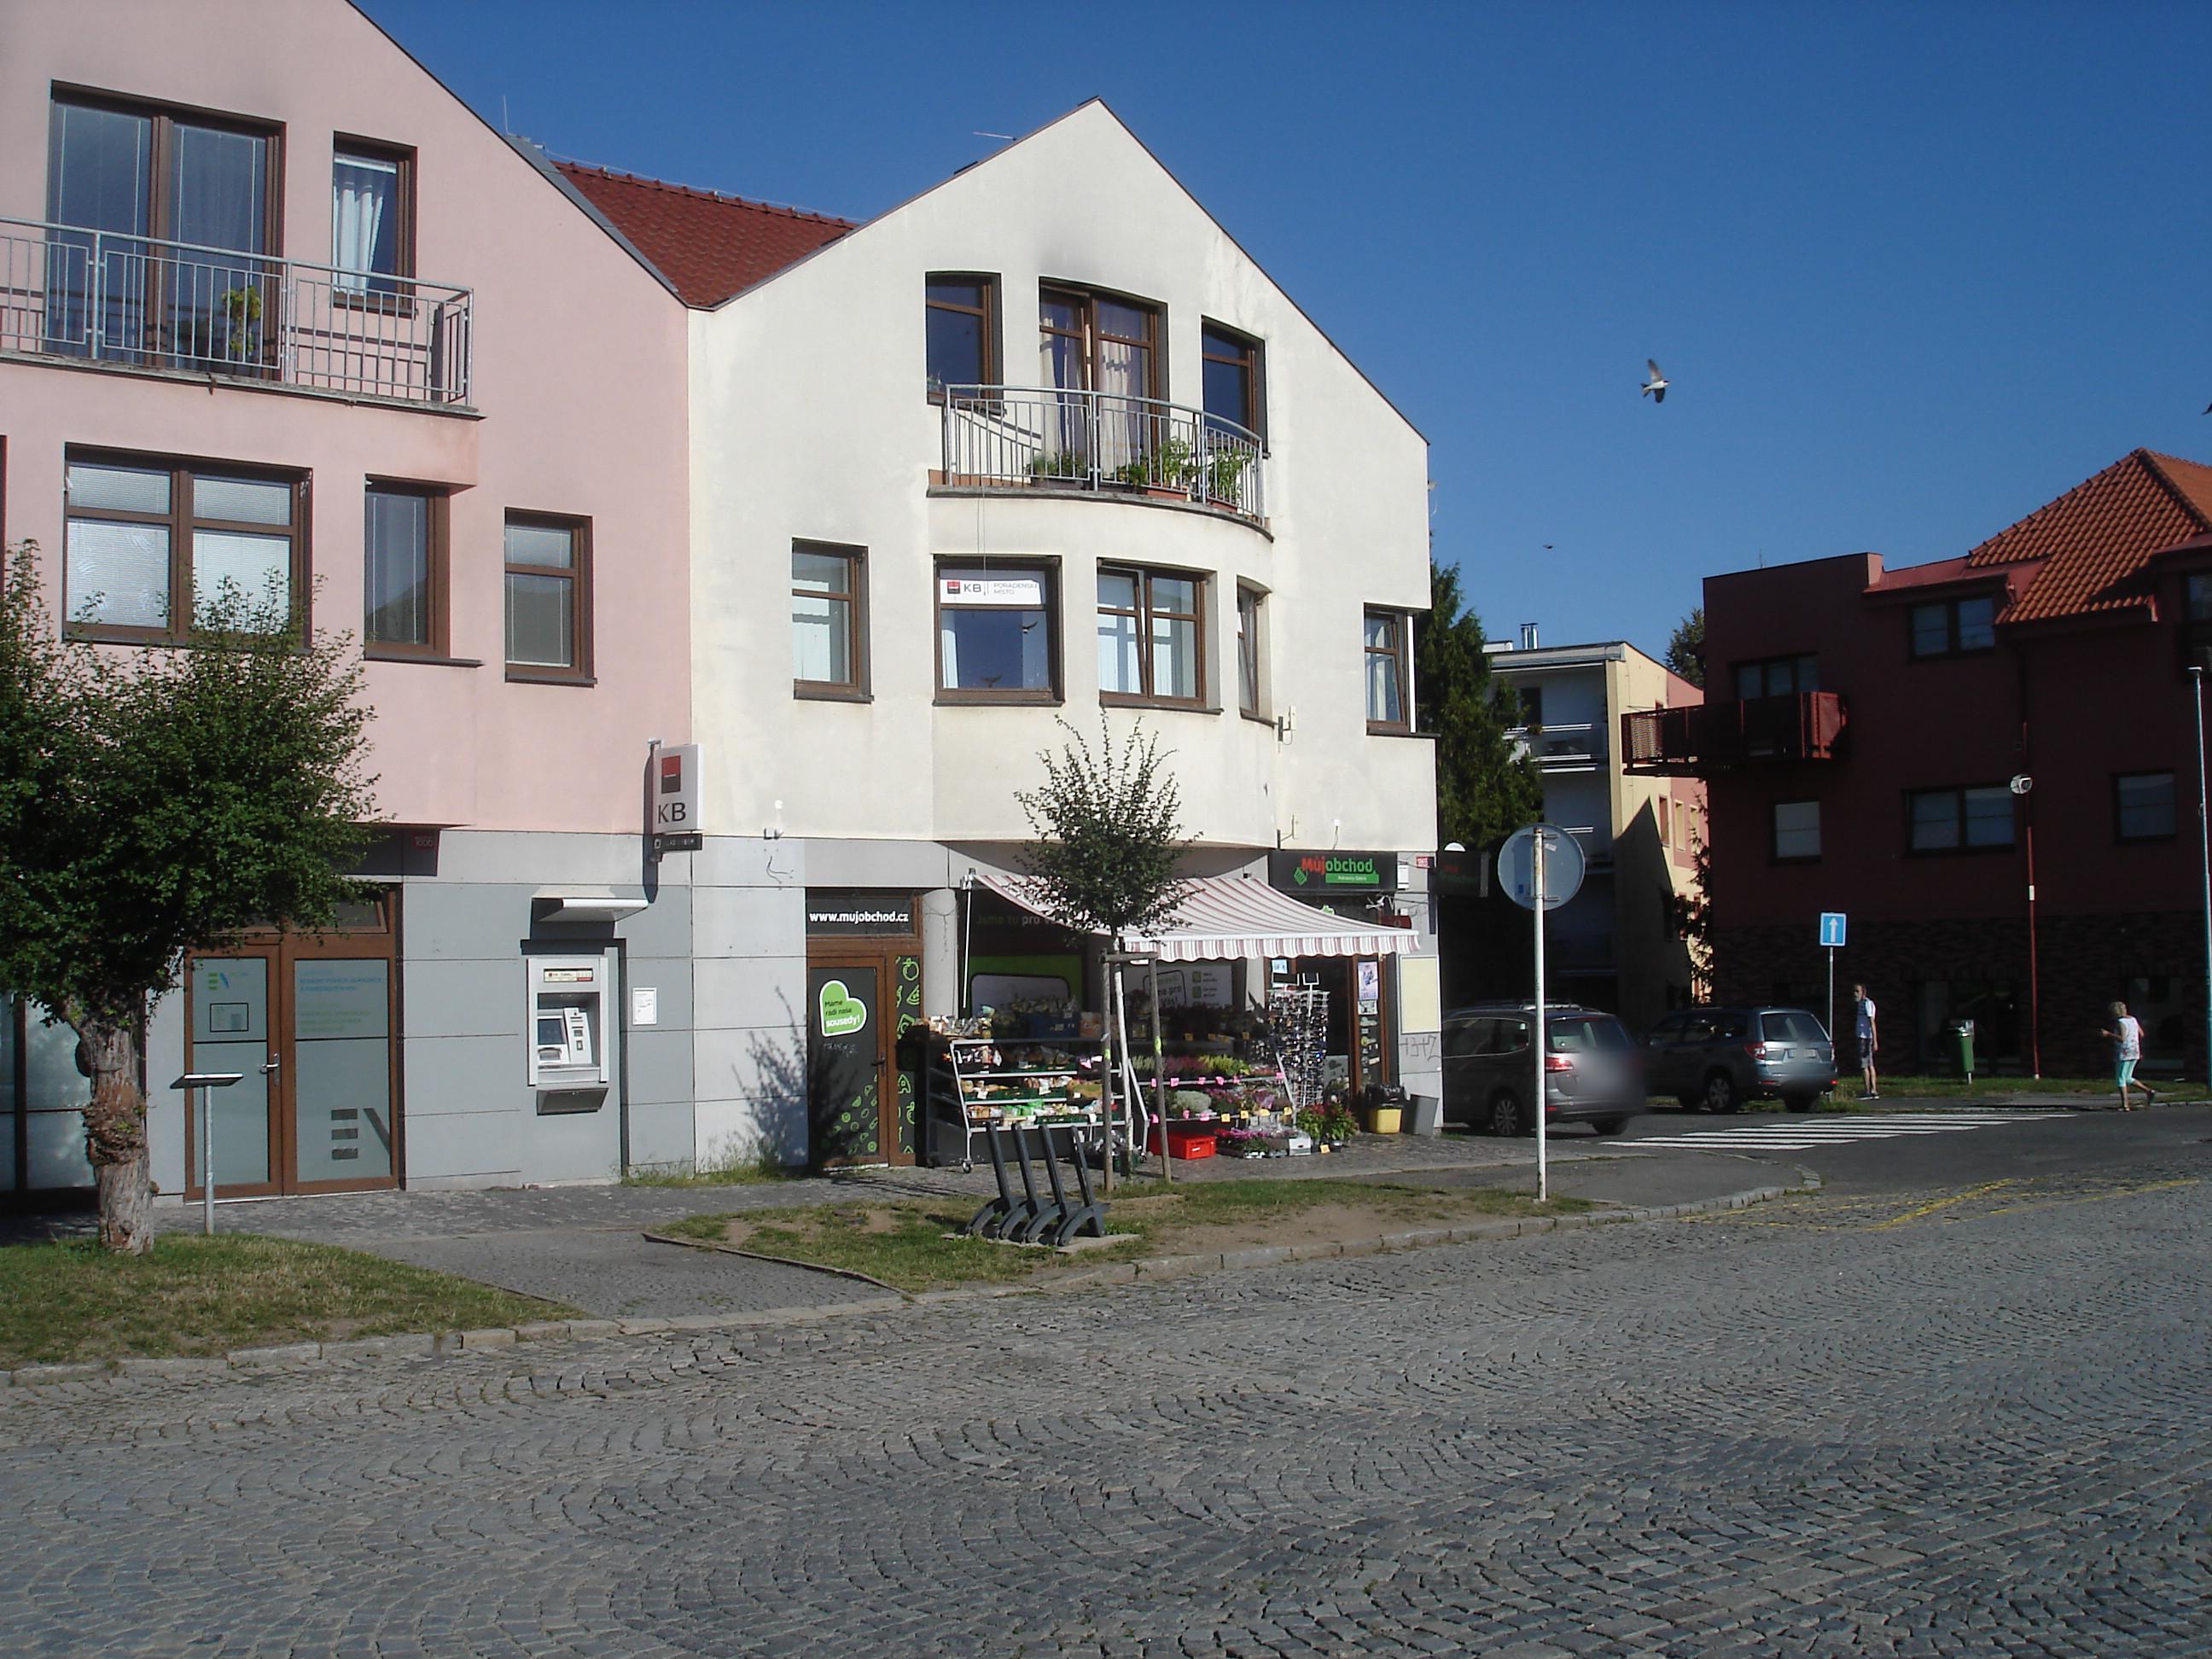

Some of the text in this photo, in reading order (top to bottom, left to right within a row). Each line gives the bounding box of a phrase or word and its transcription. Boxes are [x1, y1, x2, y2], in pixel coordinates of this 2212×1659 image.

[963, 584, 981, 593] KB
[658, 802, 686, 824] KB
[809, 911, 909, 924] www.mujobchod.cz
[1022, 915, 1040, 927] pro
